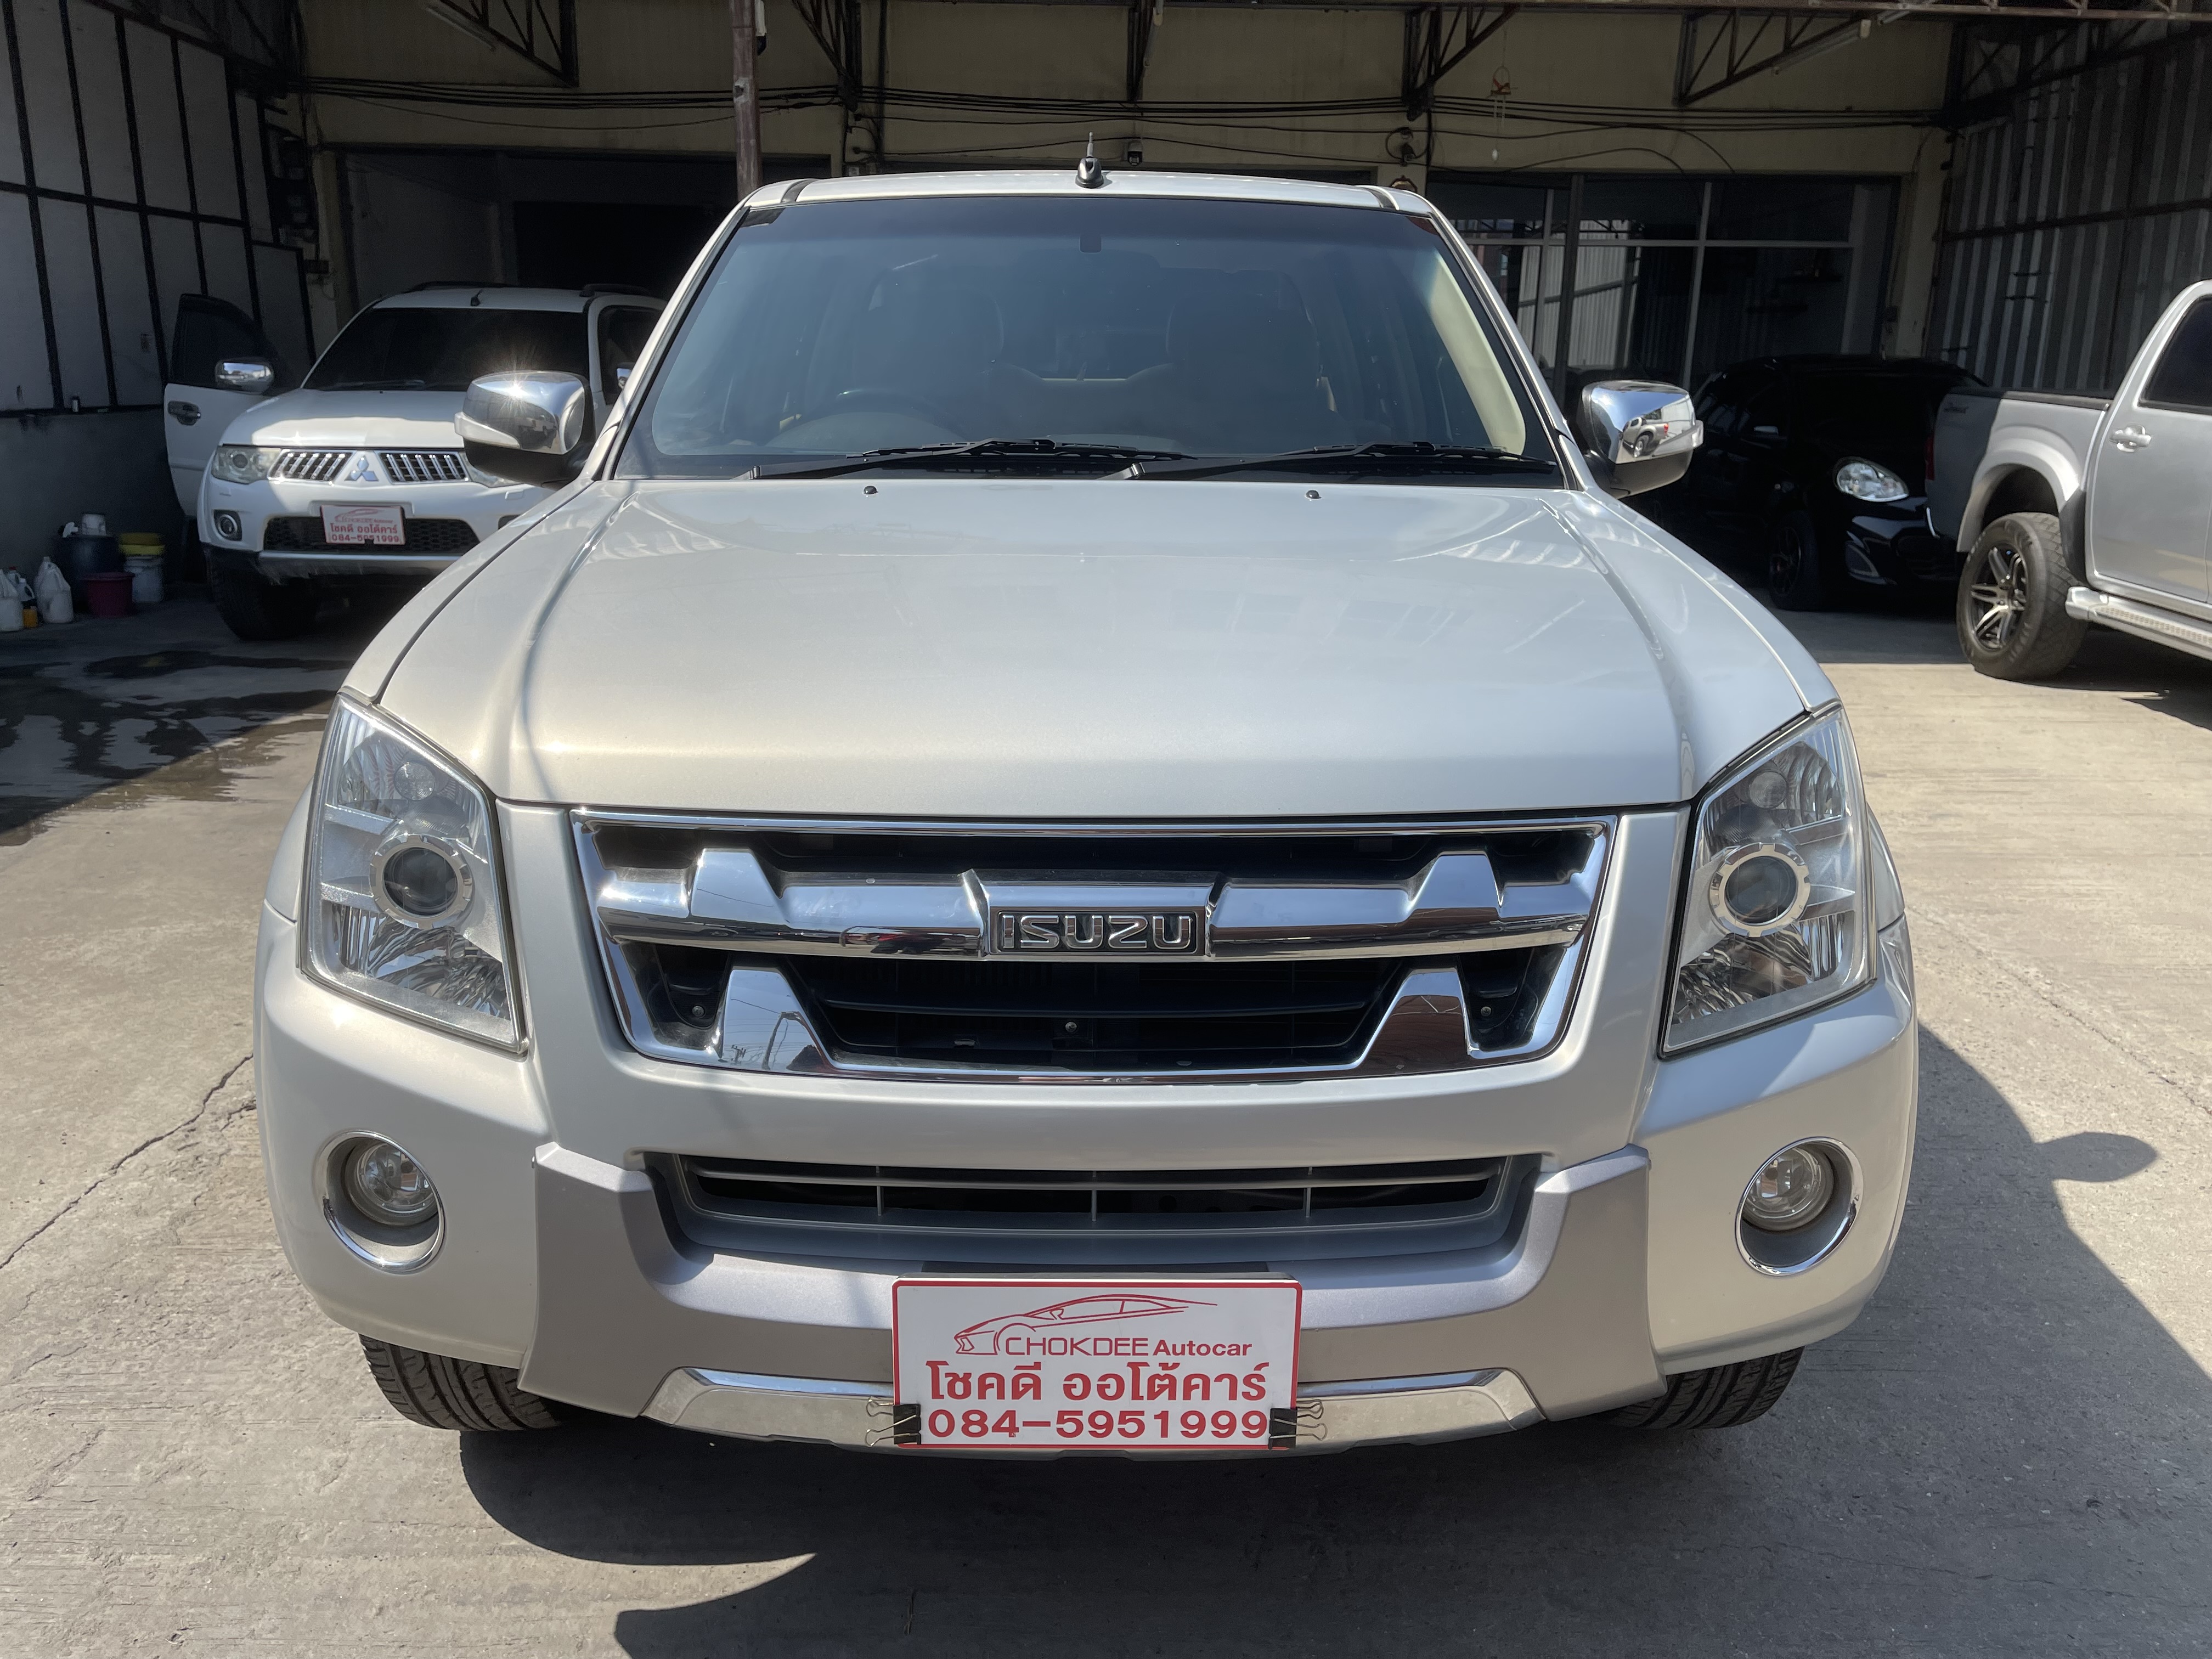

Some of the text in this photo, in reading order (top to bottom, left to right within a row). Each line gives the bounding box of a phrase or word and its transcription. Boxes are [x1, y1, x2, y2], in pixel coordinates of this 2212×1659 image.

[1002, 915, 1192, 950] ISUZU
[1005, 1336, 1252, 1357] CHOKDEE Autocar
[925, 1360, 1270, 1402] โชคดี ออโต้คาร์
[928, 1408, 1268, 1439] 084-5951999
